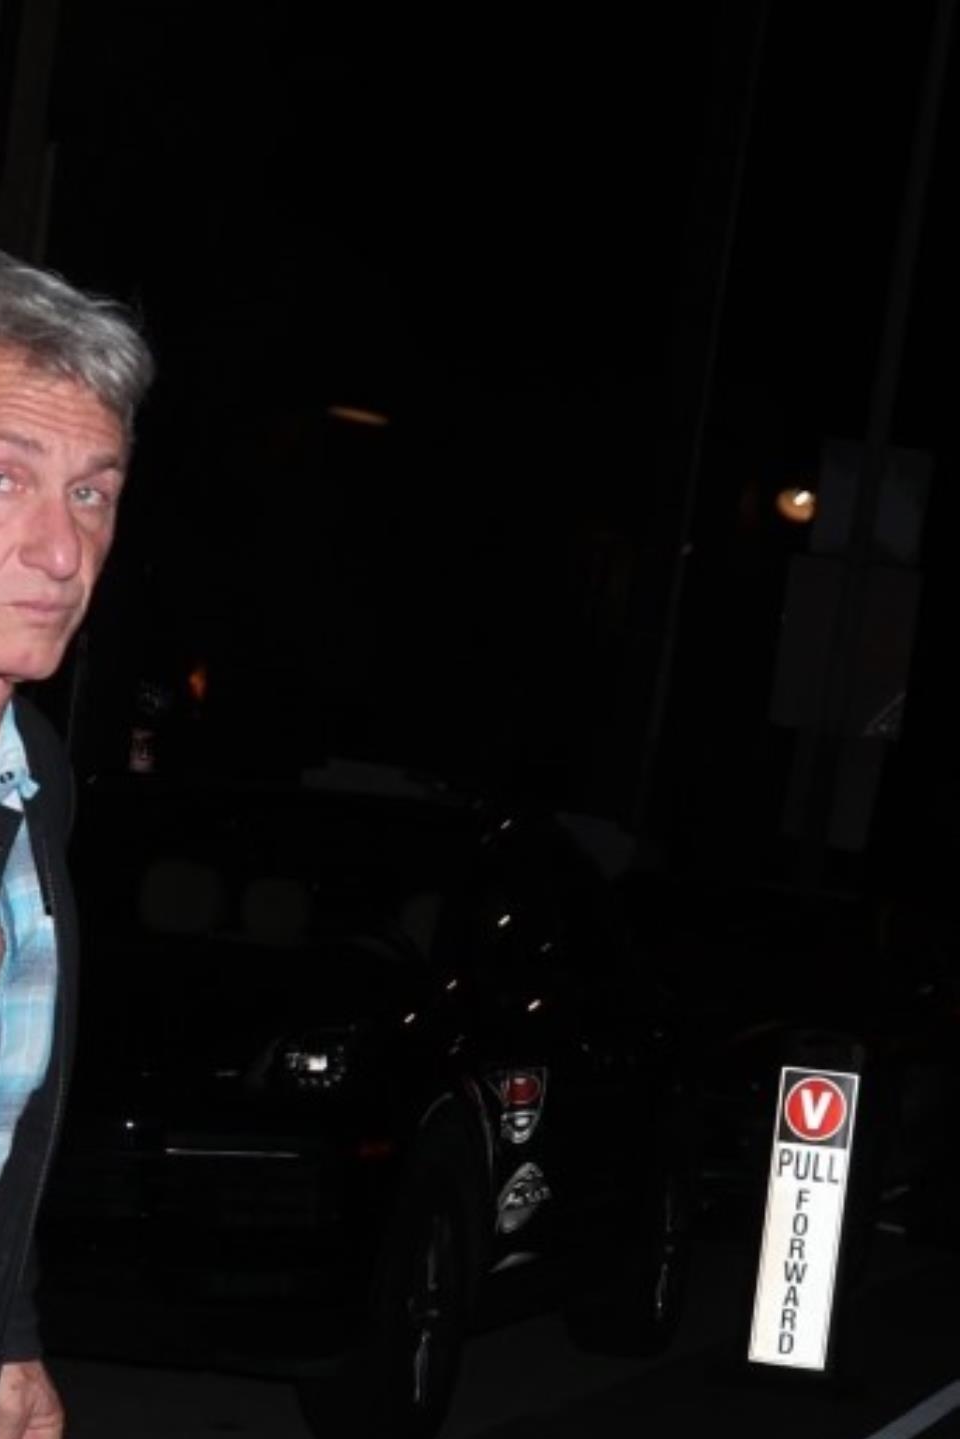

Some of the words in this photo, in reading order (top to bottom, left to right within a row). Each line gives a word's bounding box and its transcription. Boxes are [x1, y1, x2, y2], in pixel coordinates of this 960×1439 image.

[800, 1088, 834, 1131] V
[777, 1148, 840, 1184] PULL
[777, 1188, 810, 1355] FORWARD
